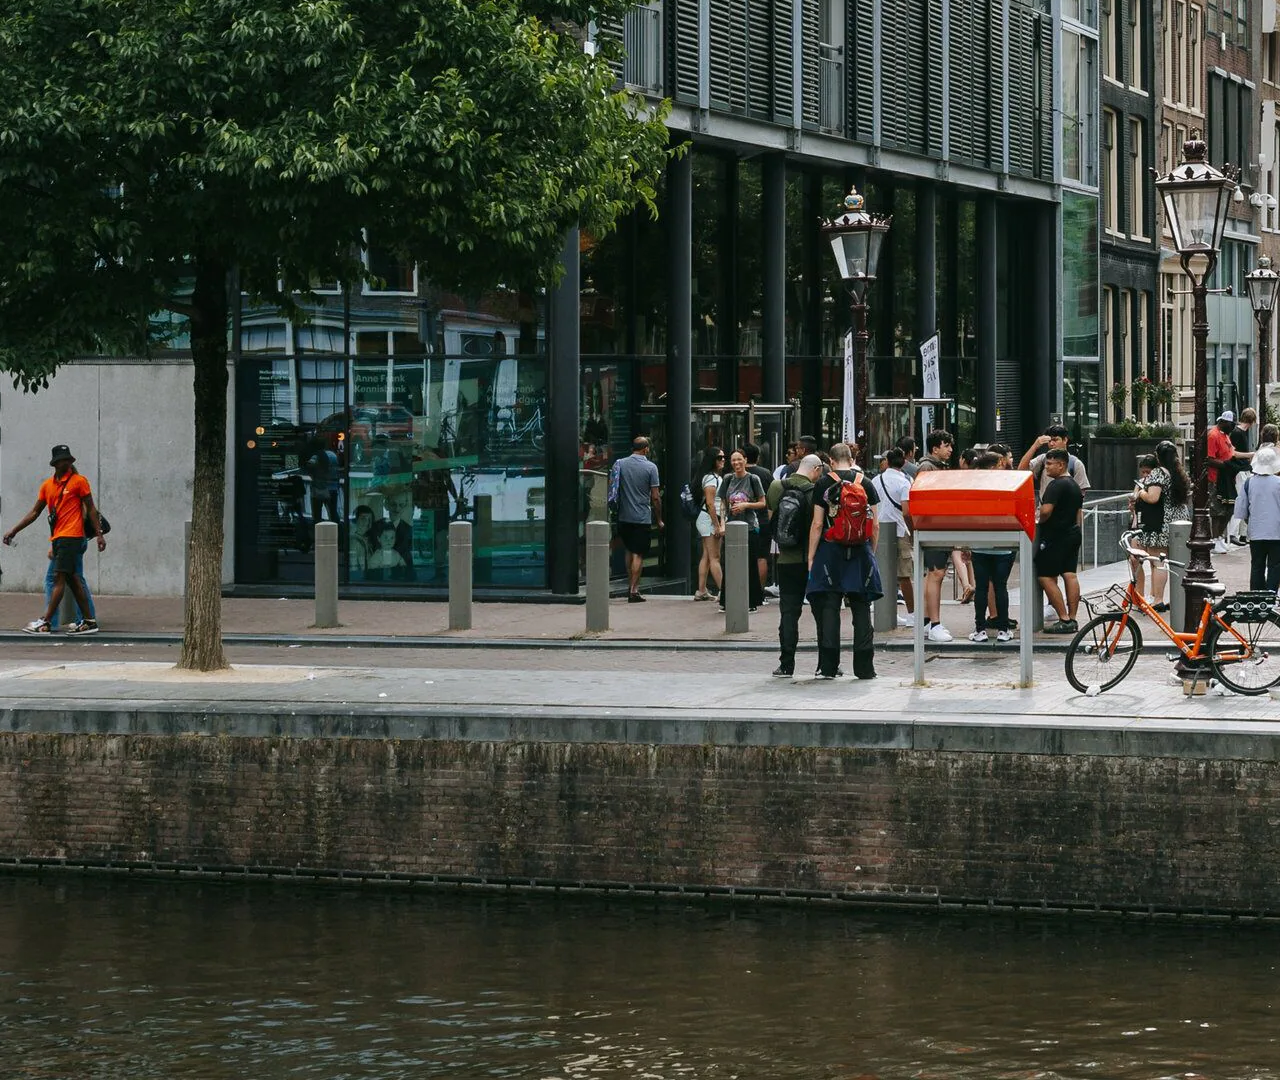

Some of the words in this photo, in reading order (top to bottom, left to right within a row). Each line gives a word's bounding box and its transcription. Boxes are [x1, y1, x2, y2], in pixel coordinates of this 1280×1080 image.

[355, 374, 379, 382] Anne
[380, 374, 405, 382] Fnk
[354, 384, 407, 393] Kennisnk
[486, 384, 509, 393] Ane
[511, 384, 536, 393] ank
[486, 394, 536, 405] Kowdge
